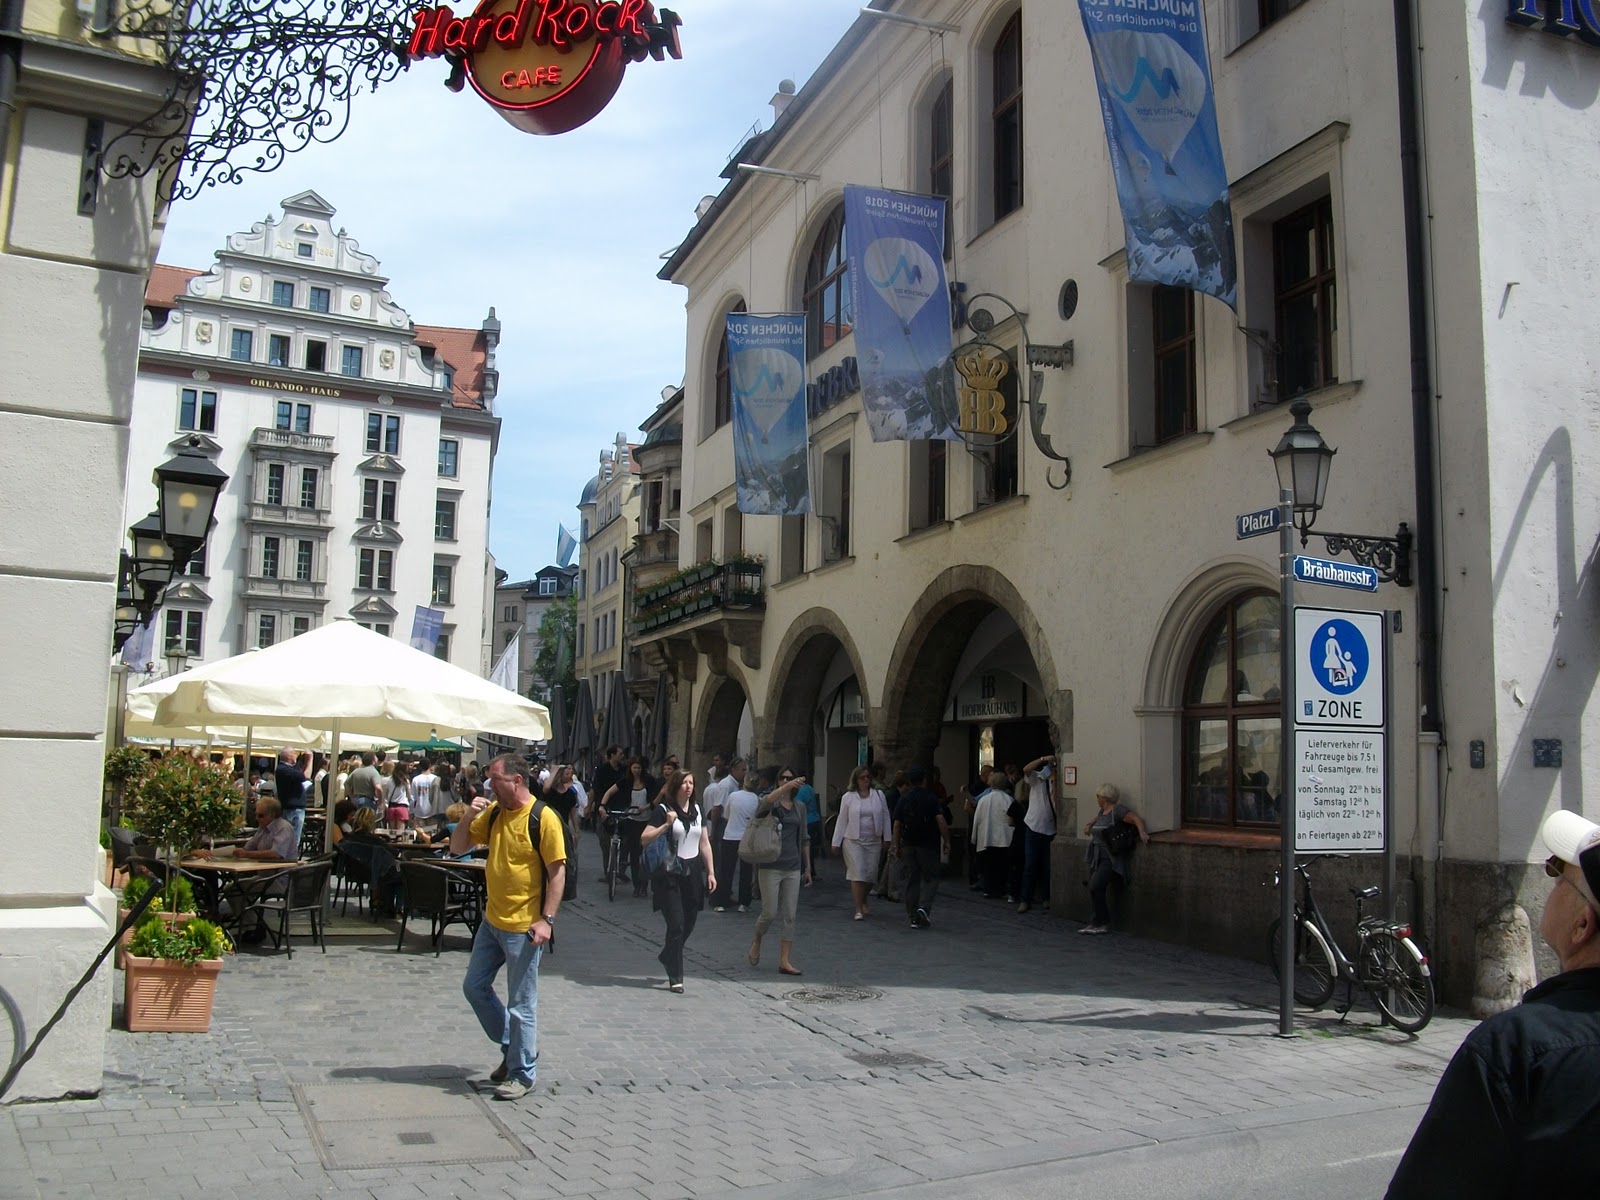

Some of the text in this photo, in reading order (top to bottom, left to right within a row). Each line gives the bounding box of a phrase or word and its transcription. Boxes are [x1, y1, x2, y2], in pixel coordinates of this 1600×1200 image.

[408, 0, 648, 57] Hard Rock
[501, 65, 562, 89] CAFE
[250, 378, 341, 397] ORLANDO HAUS
[958, 389, 1008, 435] HB
[1242, 510, 1274, 533] Platzl
[1303, 559, 1372, 586] Bräuhausstr.
[961, 700, 1018, 717] HOFBRÄUHAUS
[1318, 700, 1362, 719] ZONE
[1308, 739, 1373, 749] Lieferverkehr für
[1304, 751, 1345, 762] Fahrzeuge
[1347, 753, 1358, 761] bis
[1317, 764, 1364, 775] Gesamtgew.
[1365, 765, 1379, 774] frei
[1298, 786, 1312, 794] von
[1313, 785, 1345, 795] Sonntag
[1371, 785, 1382, 794] bis
[1313, 797, 1347, 808] Samstag
[1298, 809, 1325, 820] täglich
[1326, 811, 1341, 819] von
[1297, 832, 1307, 840] an
[1308, 830, 1350, 841] Feiertagen
[1351, 831, 1361, 840] ab
